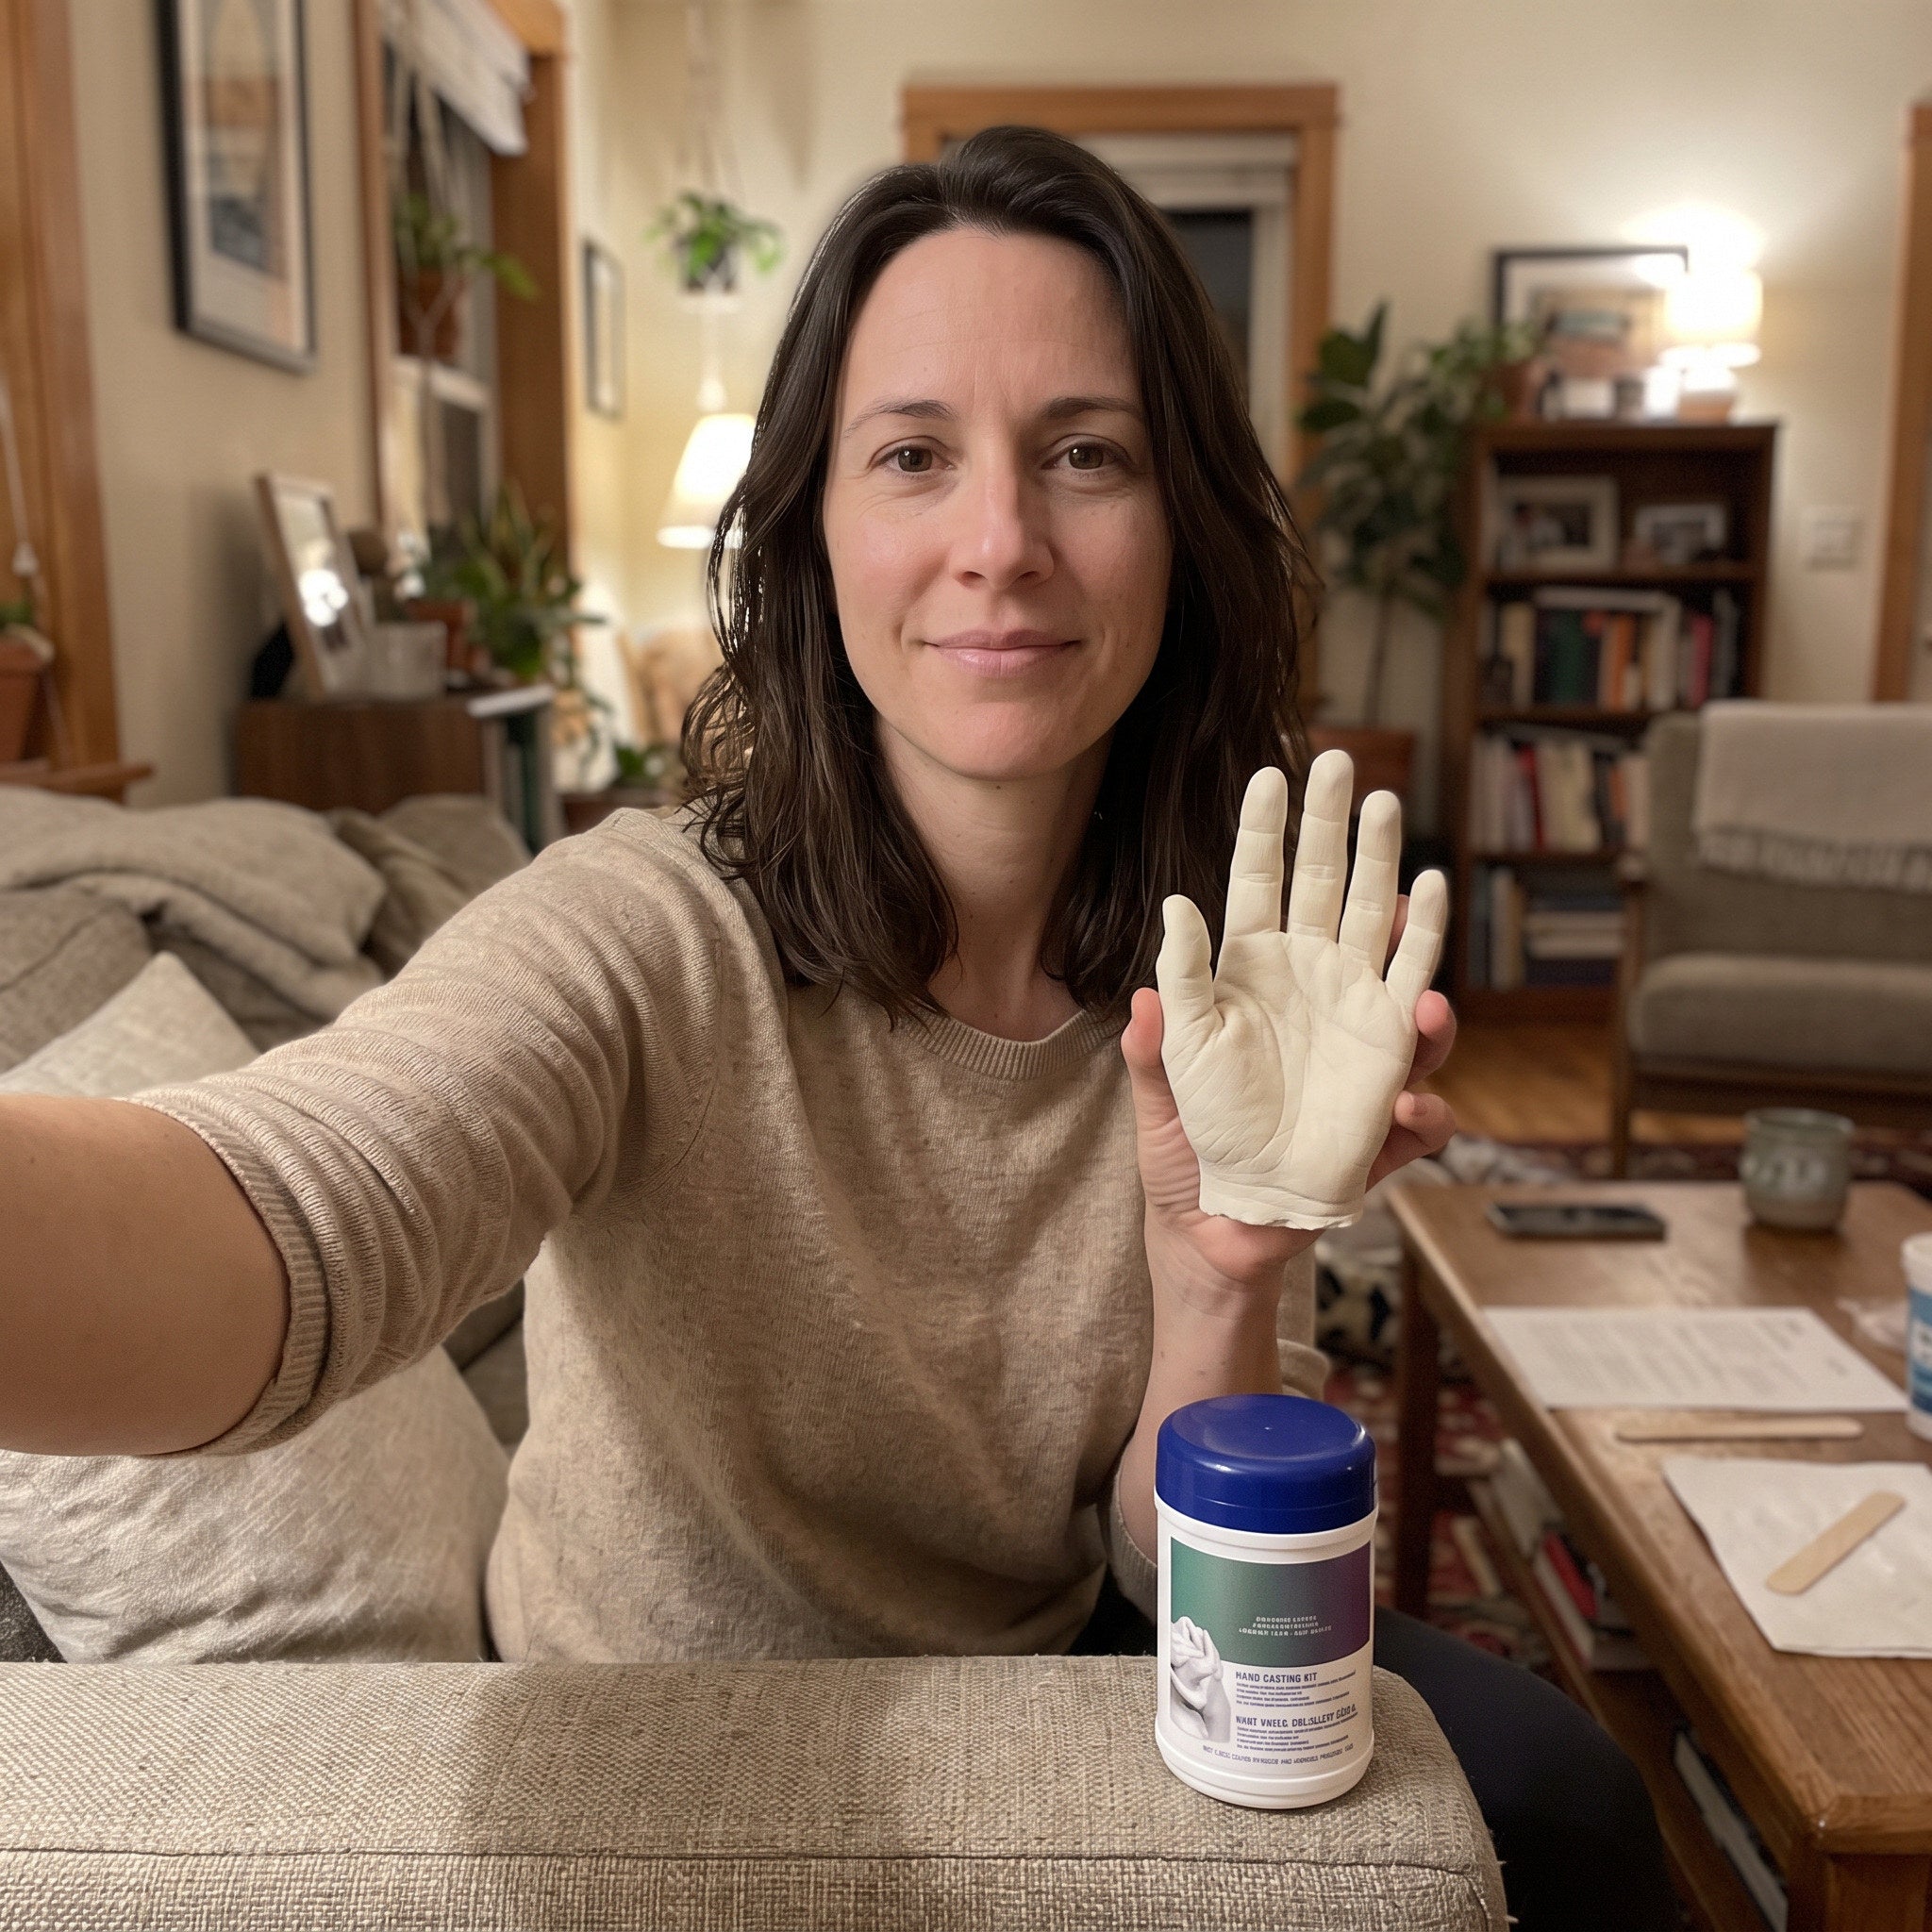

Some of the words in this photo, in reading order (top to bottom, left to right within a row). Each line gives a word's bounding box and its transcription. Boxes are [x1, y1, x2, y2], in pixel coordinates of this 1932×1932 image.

[1235, 1671, 1260, 1682] HAND
[1263, 1673, 1301, 1684] CASTING
[1304, 1672, 1318, 1682] KIT
